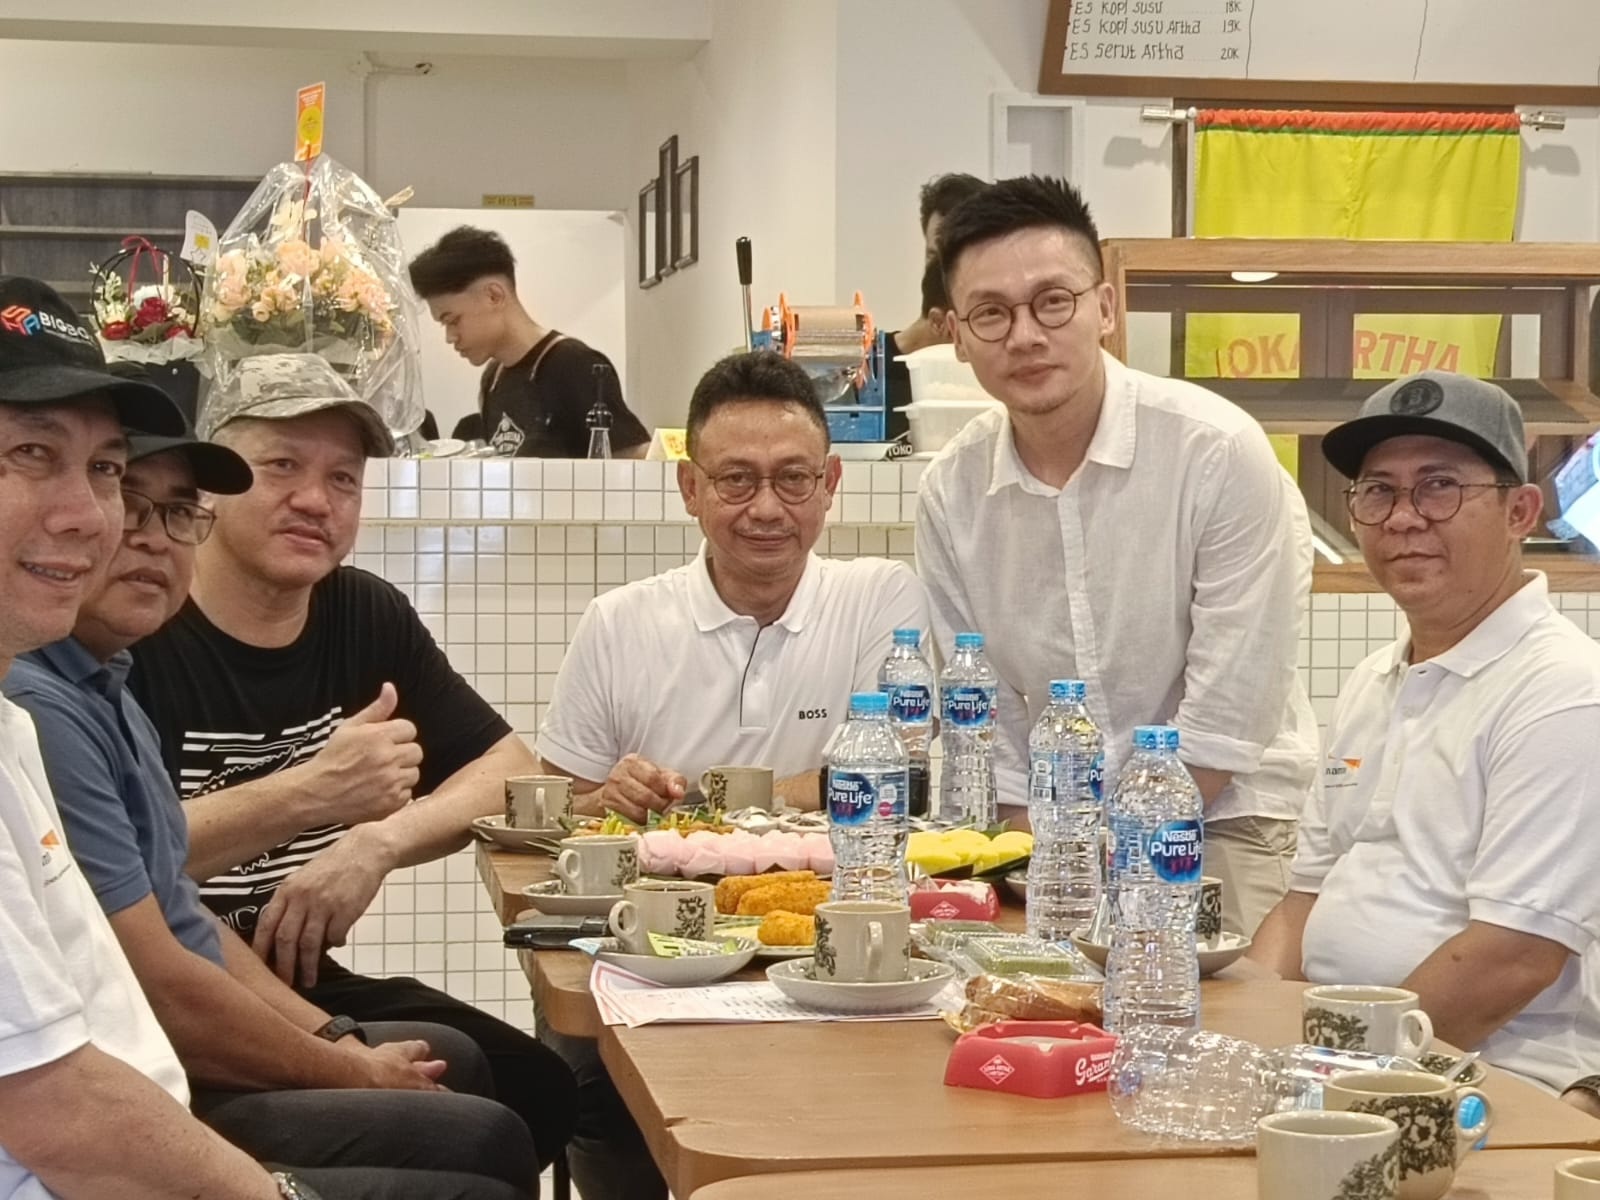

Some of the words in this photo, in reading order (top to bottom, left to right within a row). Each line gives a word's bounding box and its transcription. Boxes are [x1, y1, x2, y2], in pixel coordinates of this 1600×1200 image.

[1070, 42, 1089, 60] ES
[1220, 47, 1239, 60] 20K
[799, 709, 827, 720] BOSS
[849, 791, 872, 809] Life
[1150, 841, 1186, 856] Pure
